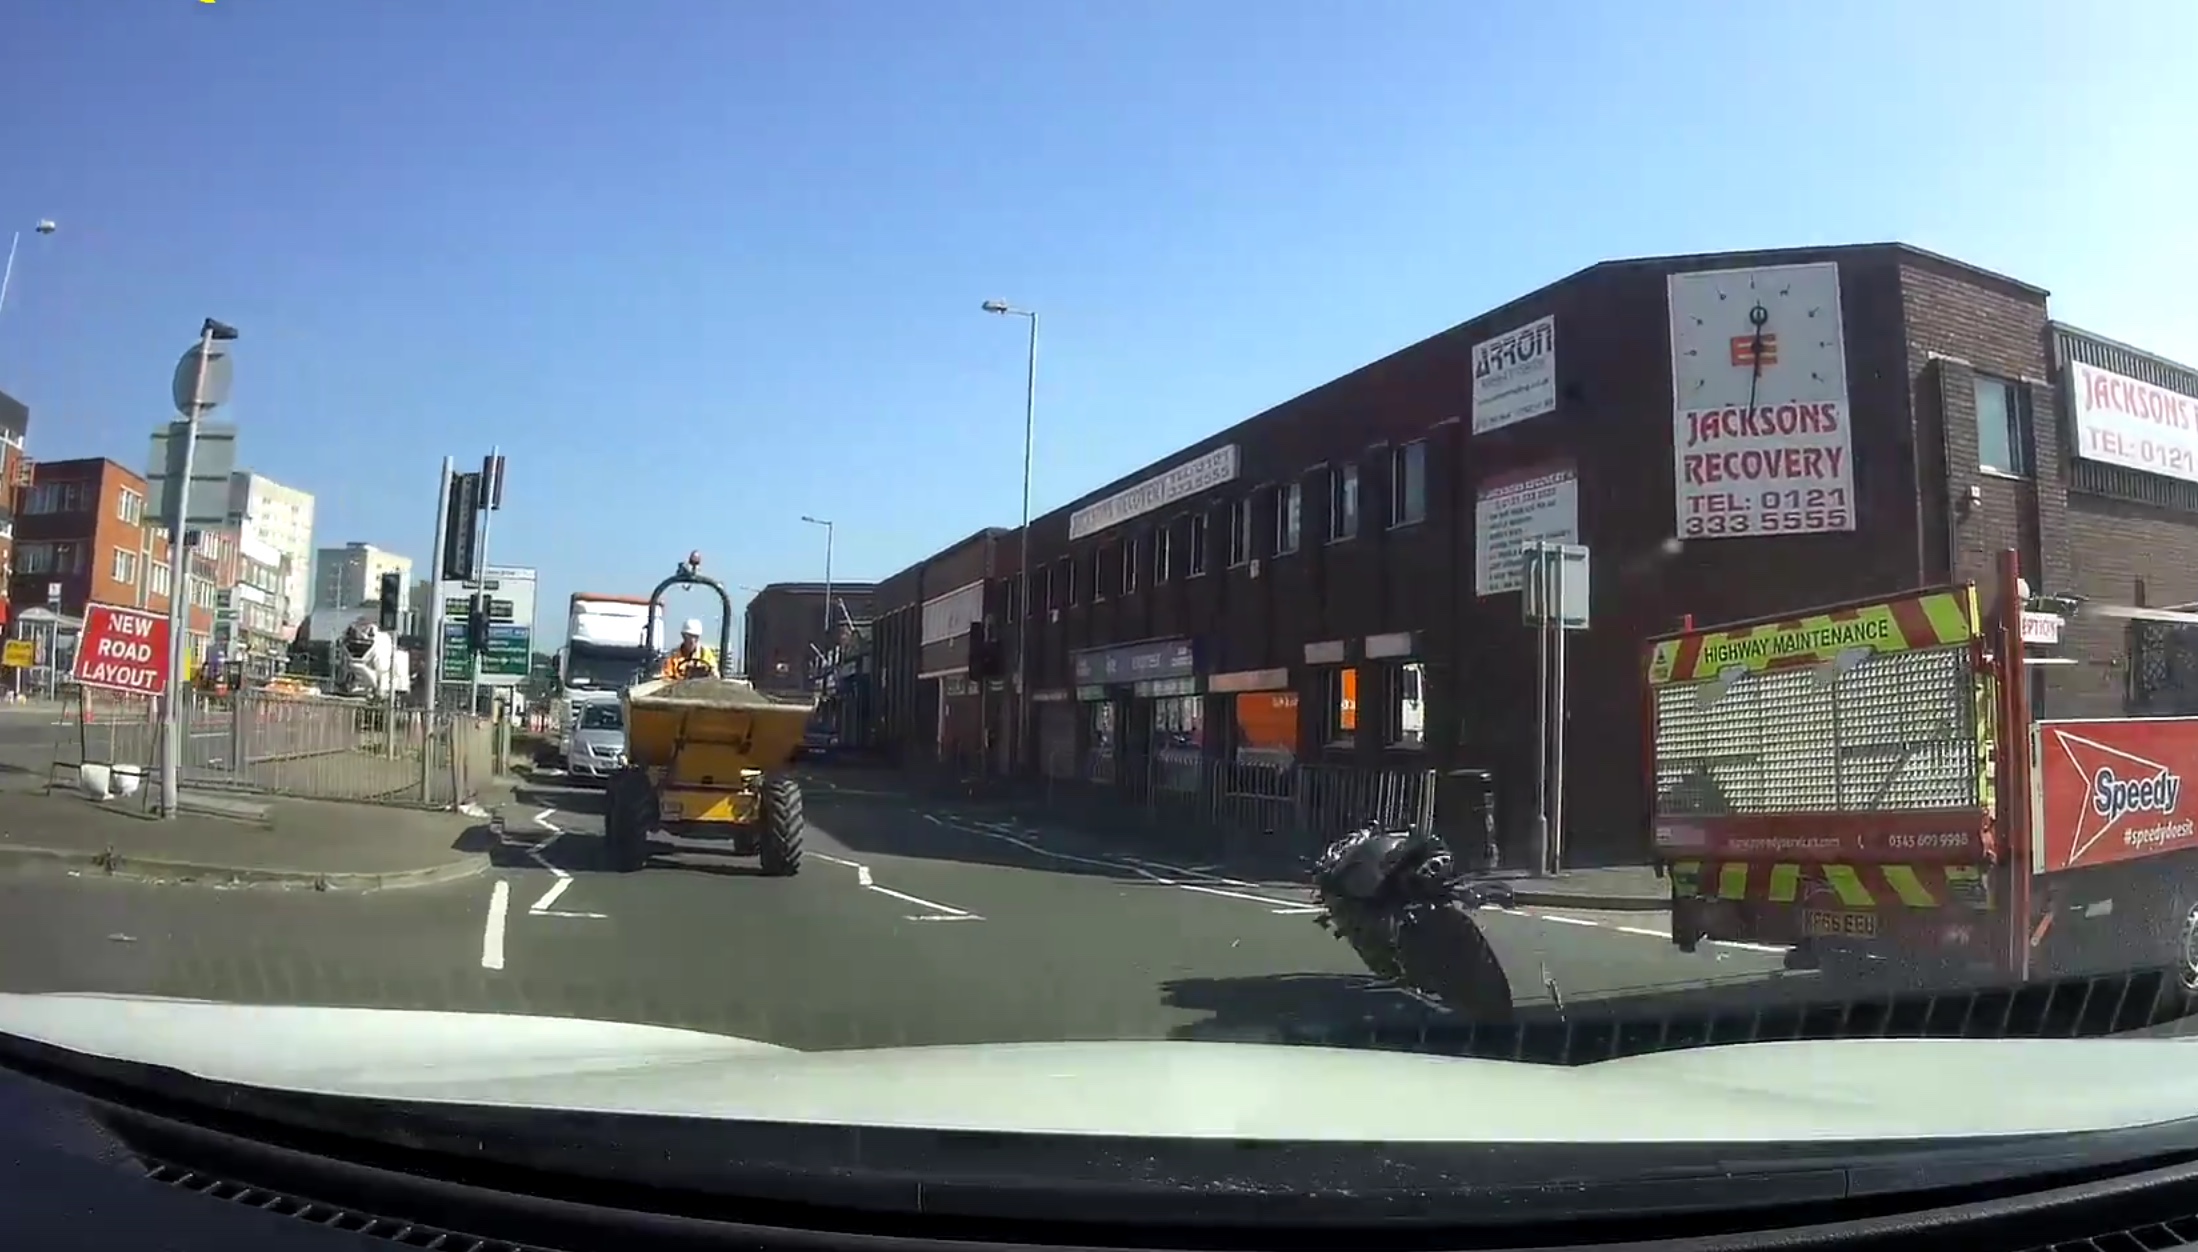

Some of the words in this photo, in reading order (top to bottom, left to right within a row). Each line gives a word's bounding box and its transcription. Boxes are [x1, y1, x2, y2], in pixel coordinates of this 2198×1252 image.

[2081, 368, 2189, 430] JACKSONS
[1687, 403, 1838, 447] JACKSONS
[1684, 447, 1843, 486] RECOVERY
[2141, 440, 2194, 472] 0121
[1687, 493, 1751, 513] TEL:
[1761, 488, 1846, 509] 0121
[1686, 514, 1749, 536] 333
[1761, 508, 1847, 531] 5555
[108, 613, 153, 637] NEW
[98, 638, 152, 662] ROAD
[1704, 636, 1769, 663] HIGHWAY
[1773, 619, 1888, 654] MAINTENANCE
[82, 660, 158, 688] LAYOUT
[2093, 767, 2180, 821] Speedy
[2123, 818, 2194, 849] #speedydoesit
